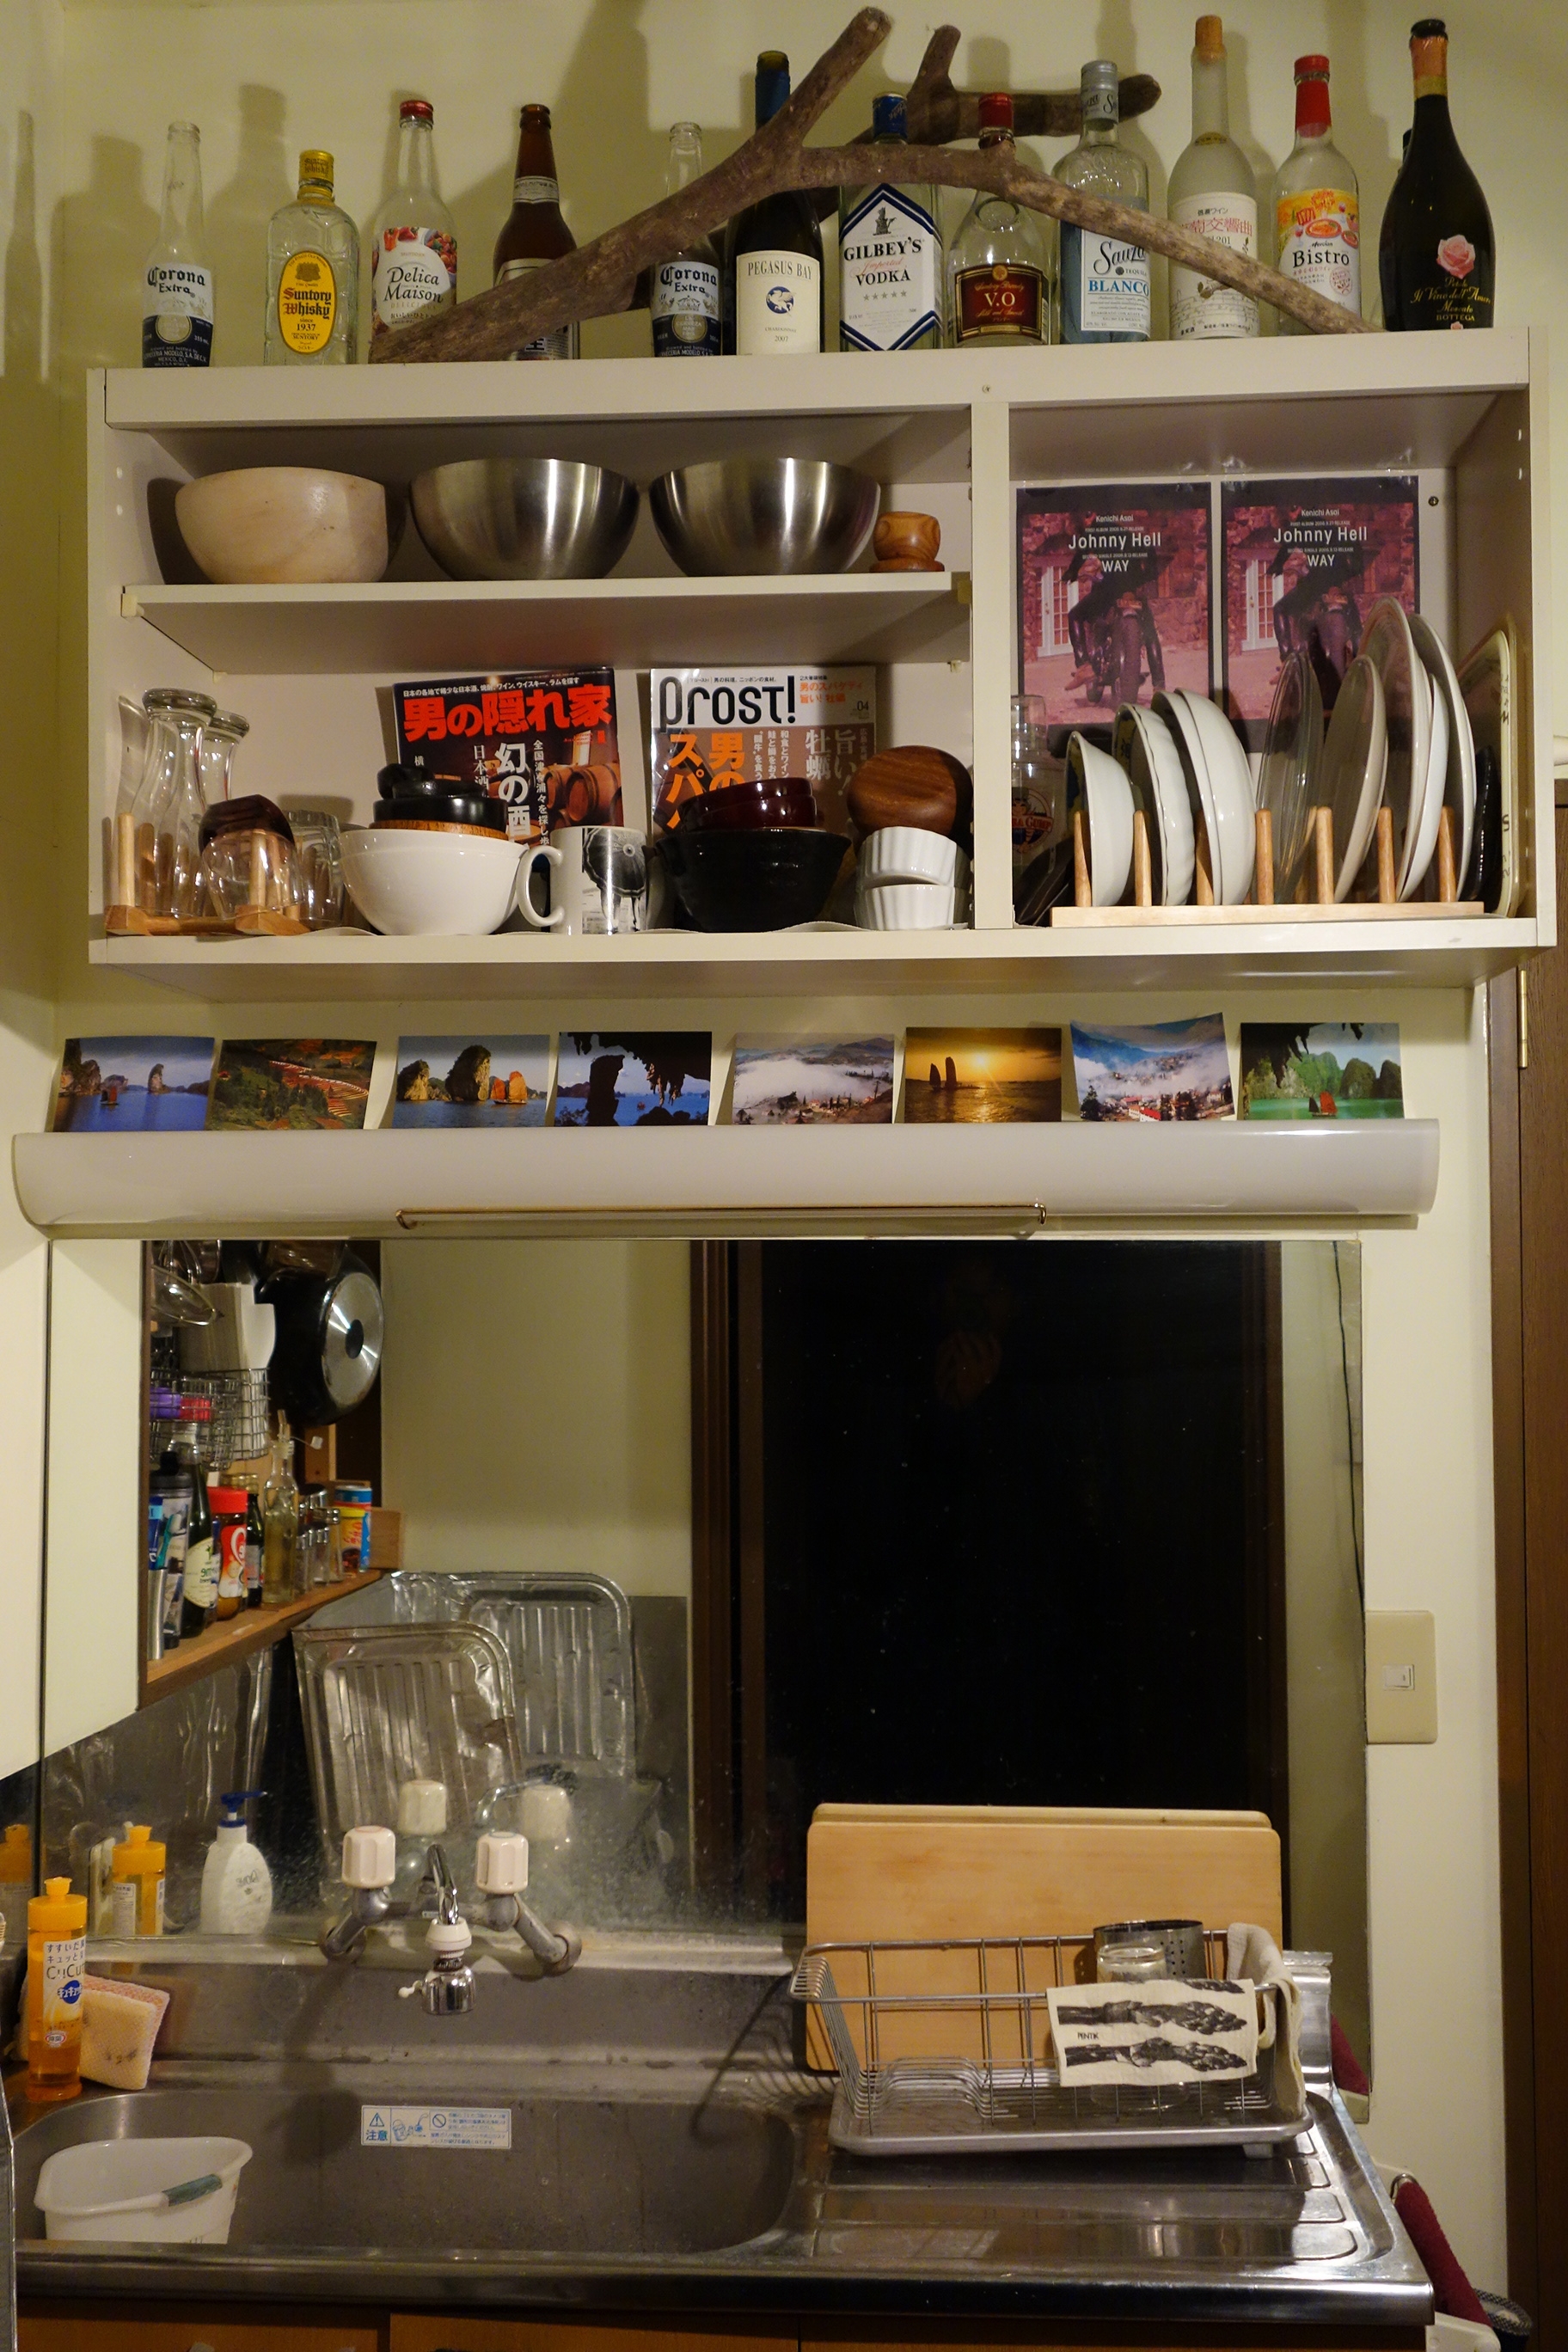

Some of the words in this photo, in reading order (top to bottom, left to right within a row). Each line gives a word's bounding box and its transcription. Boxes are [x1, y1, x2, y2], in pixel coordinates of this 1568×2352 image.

[843, 236, 922, 261] GILBEY'S
[1093, 241, 1146, 275] Sauza
[1292, 249, 1350, 268] Bistro
[148, 266, 205, 287] Corona
[387, 266, 439, 285] Delica
[660, 266, 717, 286] Corona
[748, 260, 793, 276] PEGASUS
[797, 263, 812, 280] BAY
[856, 268, 911, 287] VODKA
[158, 282, 191, 294] Extra
[283, 287, 332, 305] Suntory
[383, 282, 444, 303] Maison
[675, 282, 706, 293] Extra
[1088, 279, 1149, 297] BLANCO
[282, 302, 330, 320] Whisky
[297, 323, 316, 332] 1937
[1069, 534, 1126, 550] Johnny
[1132, 532, 1161, 547] Hell
[1273, 528, 1332, 545] Johnny
[1338, 526, 1367, 542] Hell
[1101, 560, 1130, 573] WAY
[1308, 554, 1335, 567] WAY
[403, 683, 613, 743] 男の隠れ家
[857, 701, 869, 711] 04
[665, 734, 703, 830] スパ
[365, 2129, 389, 2141] 注意
